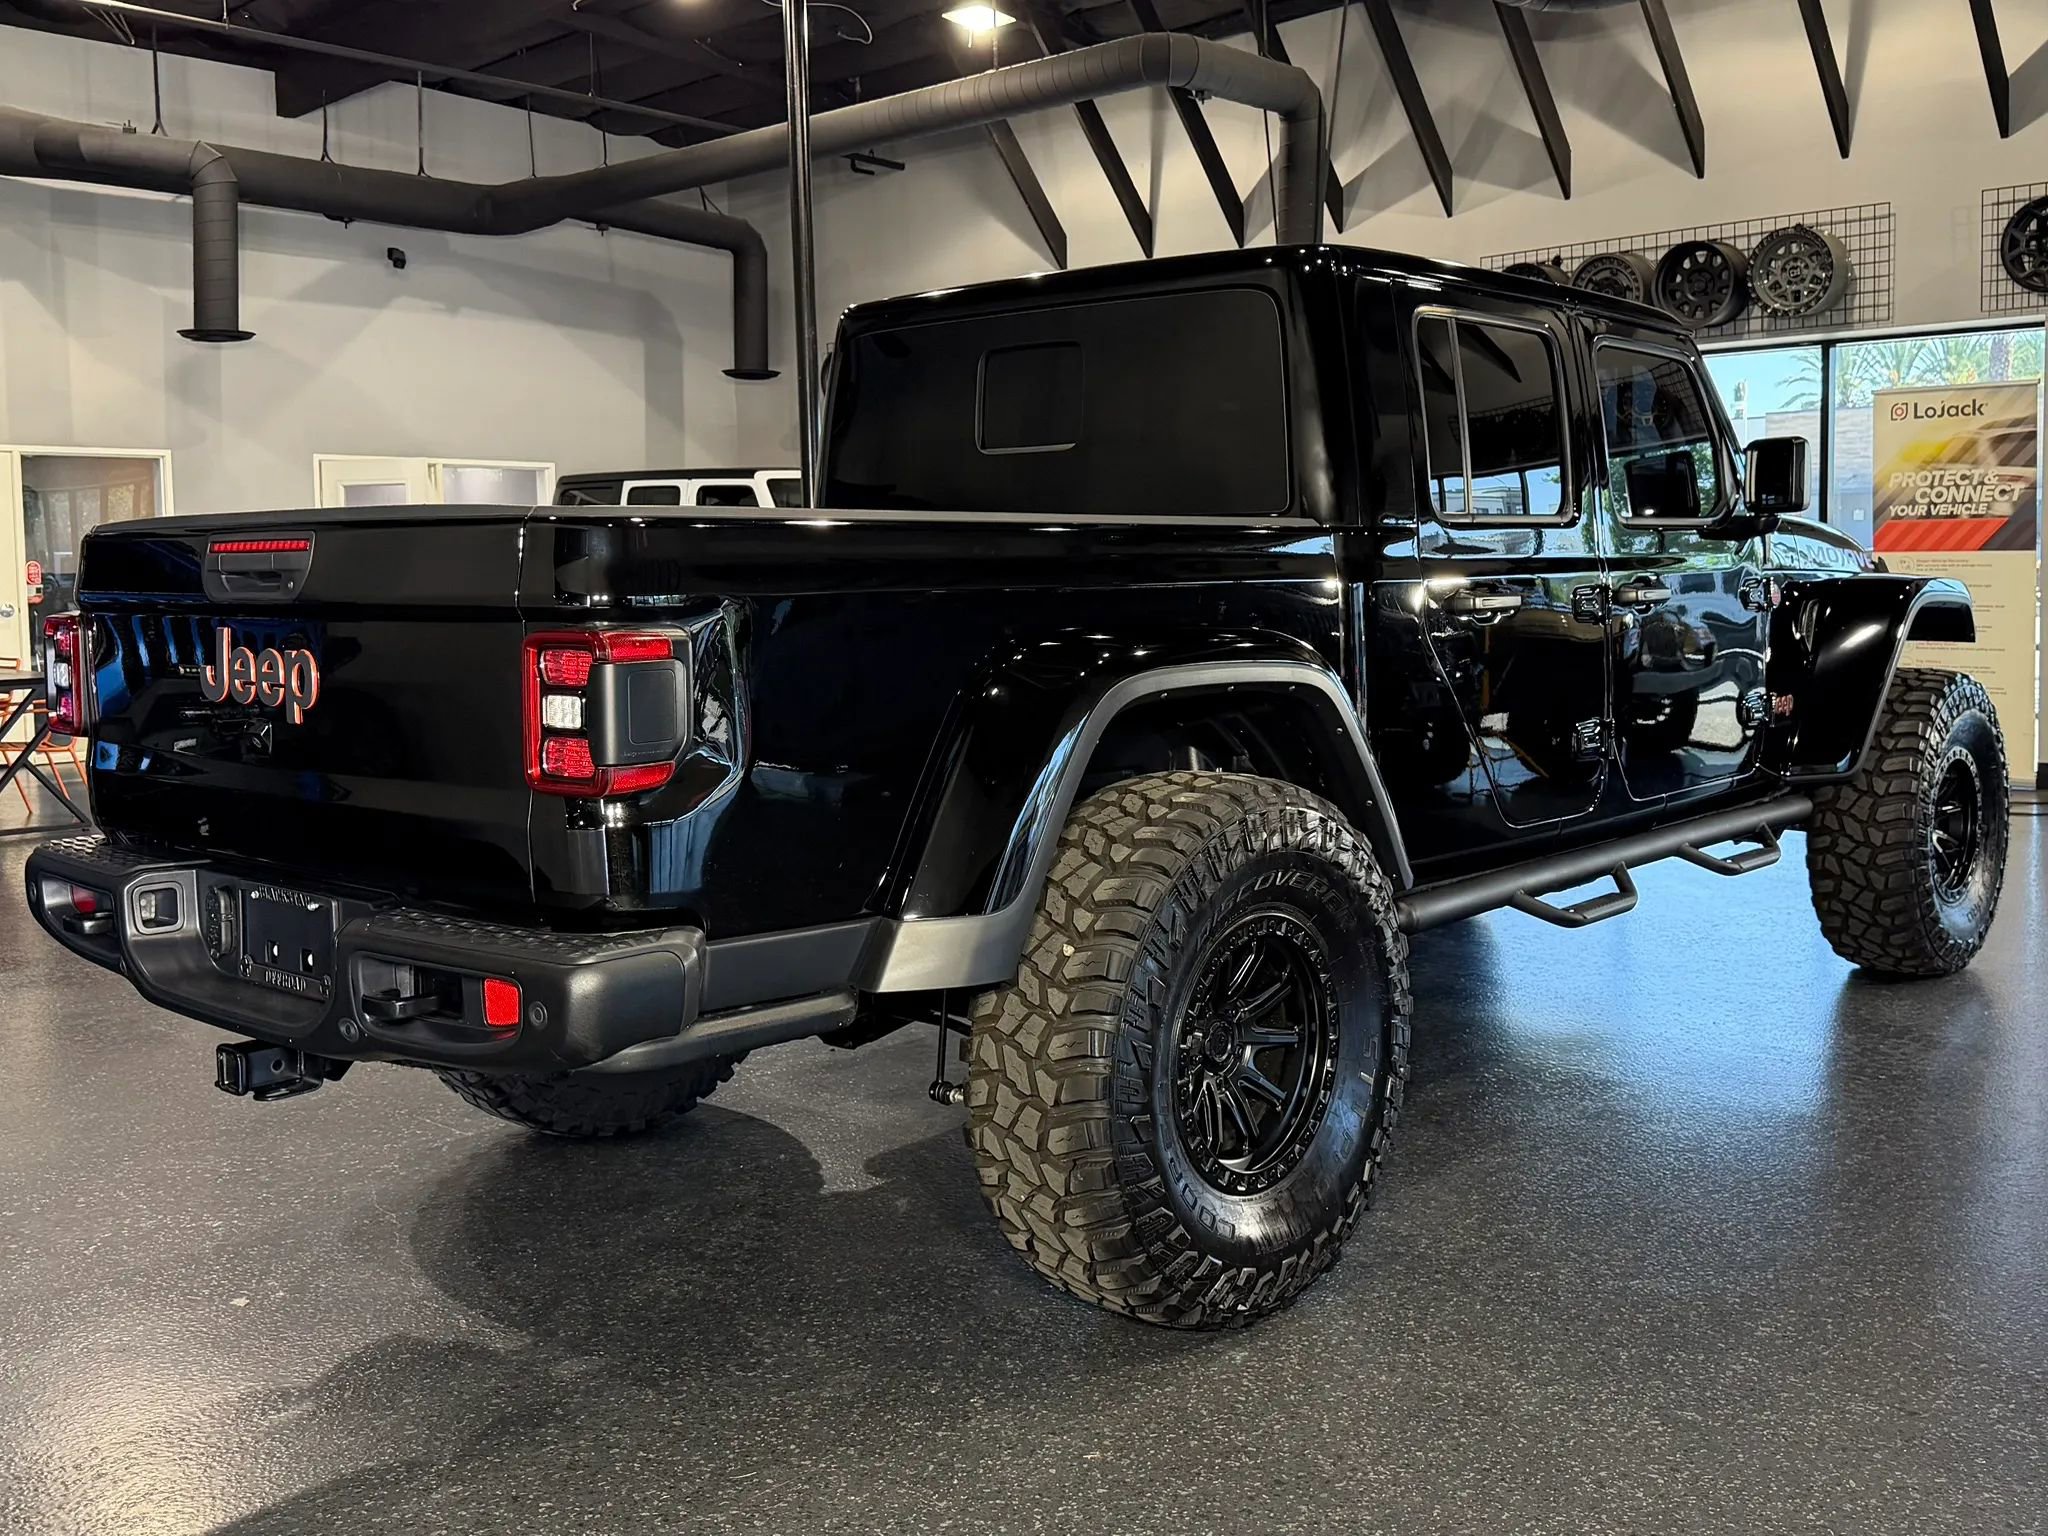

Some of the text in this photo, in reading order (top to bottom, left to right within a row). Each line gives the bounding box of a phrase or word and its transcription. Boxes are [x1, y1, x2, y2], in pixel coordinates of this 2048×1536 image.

[1888, 469, 2000, 489] PROTECT &
[1915, 484, 2026, 504] CONNECT
[1889, 502, 1988, 517] YOUR VEHICLE
[200, 627, 320, 725] Jeep
